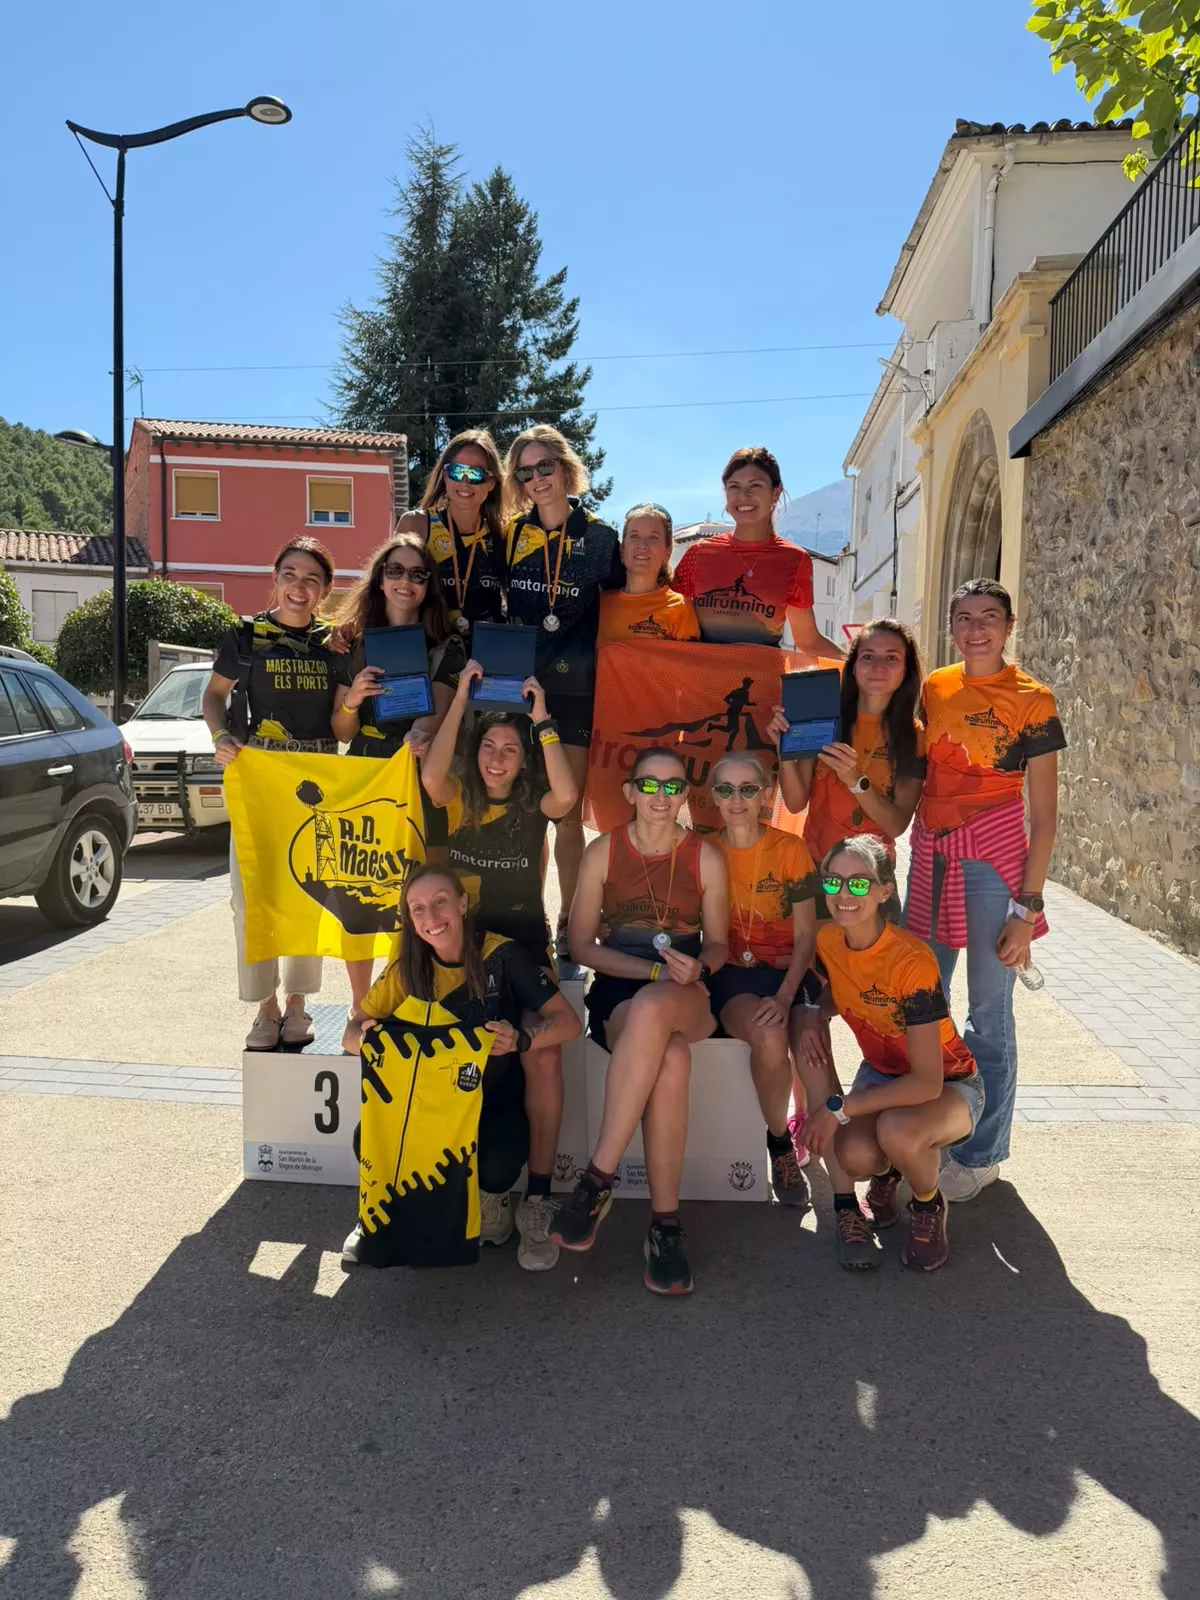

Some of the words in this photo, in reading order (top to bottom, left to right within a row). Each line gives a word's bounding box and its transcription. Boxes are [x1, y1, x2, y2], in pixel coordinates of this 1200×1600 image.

[693, 595, 776, 618] railrunning
[266, 659, 328, 674] MAESTRAZGO
[275, 675, 292, 689] ELS
[297, 676, 328, 690] PORTS
[338, 815, 381, 845] A.D.
[314, 1070, 340, 1135] 3
[730, 1161, 753, 1170] TRAIL
